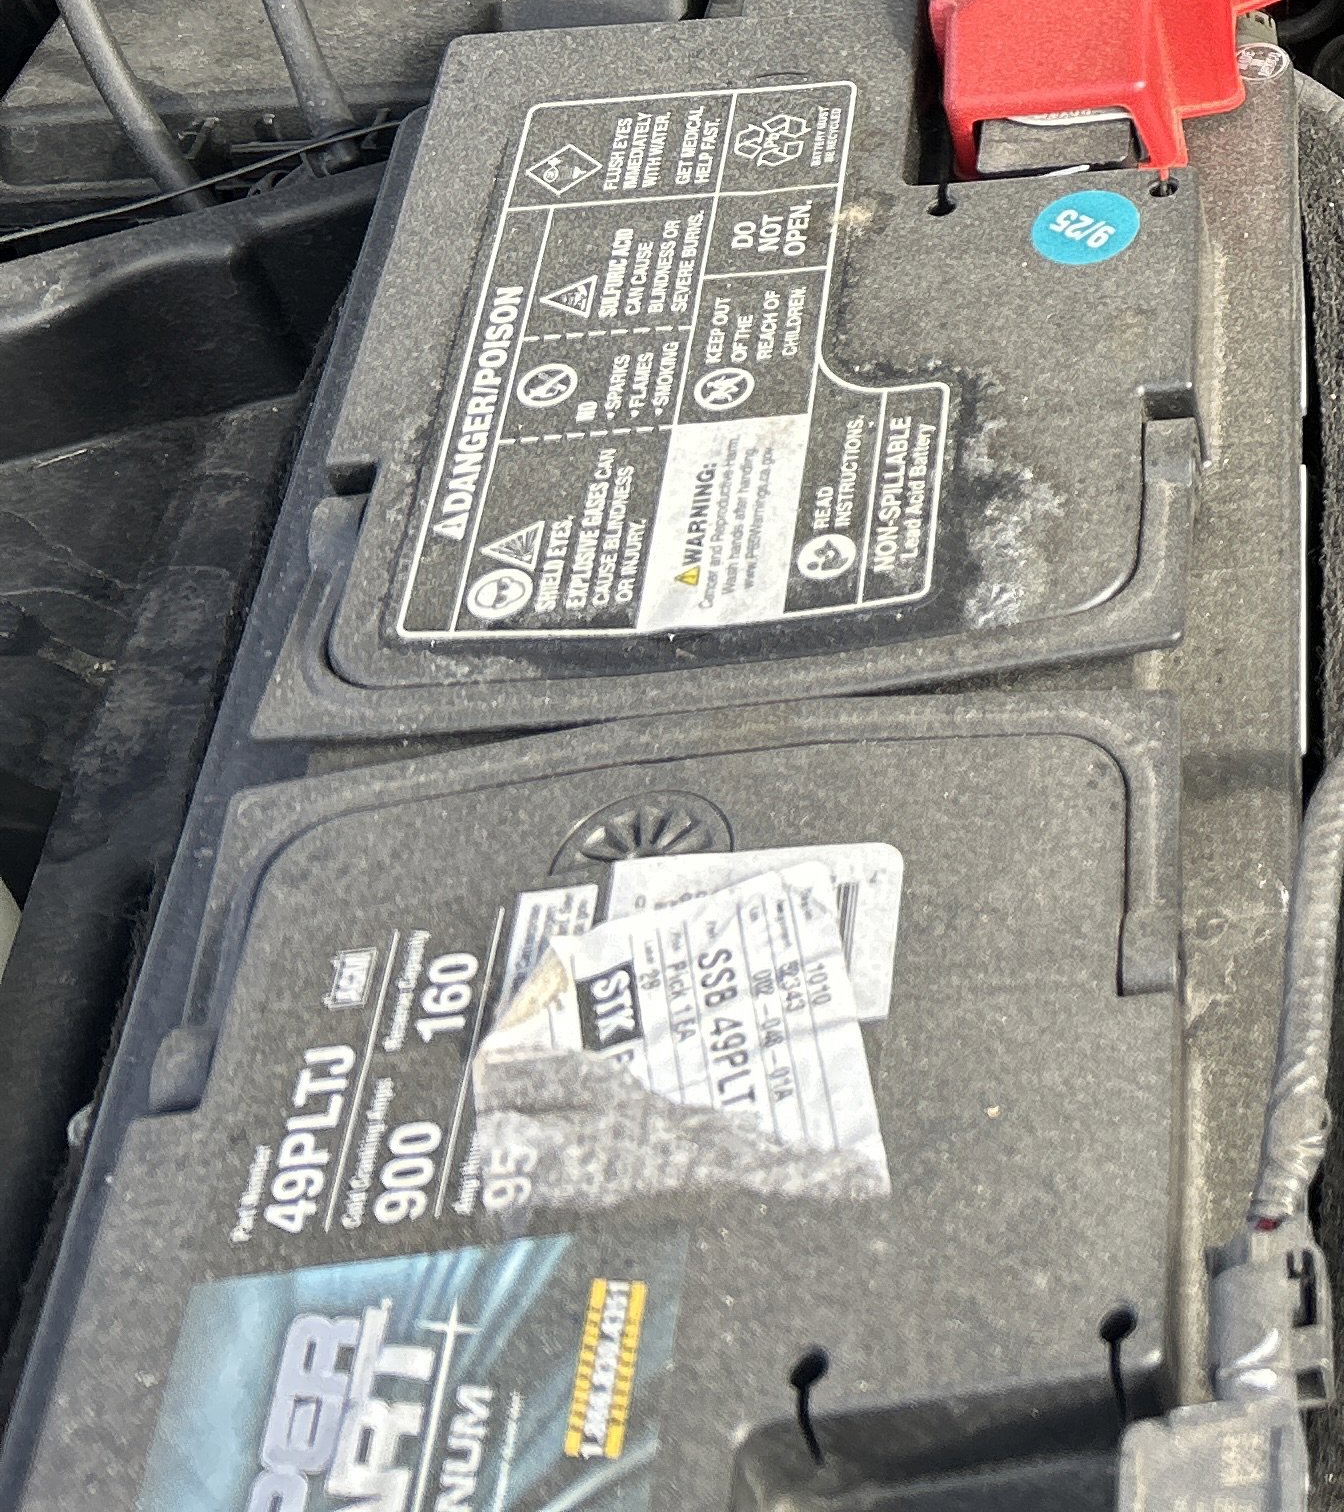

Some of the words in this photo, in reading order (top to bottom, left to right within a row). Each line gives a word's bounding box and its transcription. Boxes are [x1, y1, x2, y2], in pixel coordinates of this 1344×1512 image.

[614, 117, 633, 148] EYES
[623, 112, 652, 189] IMMEDIATELY
[642, 151, 660, 188] WITH
[651, 112, 671, 151] WATER.
[682, 106, 705, 157] MEDICAL
[702, 118, 720, 153] FAST.
[603, 149, 626, 191] FLUSH
[675, 159, 691, 185] GET
[695, 155, 712, 184] HELP
[611, 228, 634, 257] ACID
[681, 210, 705, 259] BURNS.
[731, 221, 757, 250] DO
[758, 214, 784, 253] NOT
[783, 200, 813, 257] OPEN.
[1049, 209, 1116, 249] 9/25
[631, 241, 653, 285] CAUSE
[648, 241, 677, 314] BLINDNESS
[663, 219, 681, 239] OR
[671, 261, 695, 313] SEVERE
[598, 258, 629, 319] SULFURIC
[625, 287, 645, 317] CAN
[712, 296, 731, 326] OUT
[763, 290, 781, 310] OF
[734, 314, 754, 342] THE
[757, 313, 779, 361] REACH
[781, 286, 807, 356] CHILDREN.
[704, 328, 726, 365] KEEP
[730, 342, 748, 363] OF
[604, 354, 631, 411] SPARKS
[629, 352, 654, 409] FLAMES
[653, 341, 680, 406] SMOKING
[442, 285, 524, 513] DANGER/POISON
[575, 400, 598, 424] NO
[594, 447, 617, 480] CAN
[834, 414, 865, 527] INSTRUCTIONS.
[909, 423, 937, 479] Battery
[582, 481, 610, 528] GASES
[603, 465, 635, 552] BLINDNESS
[682, 462, 718, 566] WARNING:
[711, 470, 734, 542] Reproductive
[734, 497, 749, 520] after
[813, 485, 834, 530] READ
[873, 416, 912, 573] NON-SPILLABLE
[905, 480, 926, 516] Acid
[547, 515, 576, 558] EYES.
[621, 518, 647, 577] INJURY.
[709, 545, 723, 566] and
[728, 523, 745, 560] hands
[899, 518, 922, 562] Lead
[534, 559, 564, 612] SHIELD
[565, 529, 600, 610] EXPLOSIVE
[592, 553, 618, 607] CAUSE
[615, 579, 635, 603] OR
[698, 570, 718, 609] Cancer
[721, 561, 738, 595] Wash
[414, 951, 480, 1044] 160
[698, 948, 738, 1009] SSB
[589, 966, 636, 1045] STK
[263, 1043, 357, 1234] 49PLTJ
[373, 1120, 443, 1225] 900
[482, 1146, 541, 1210] 95
